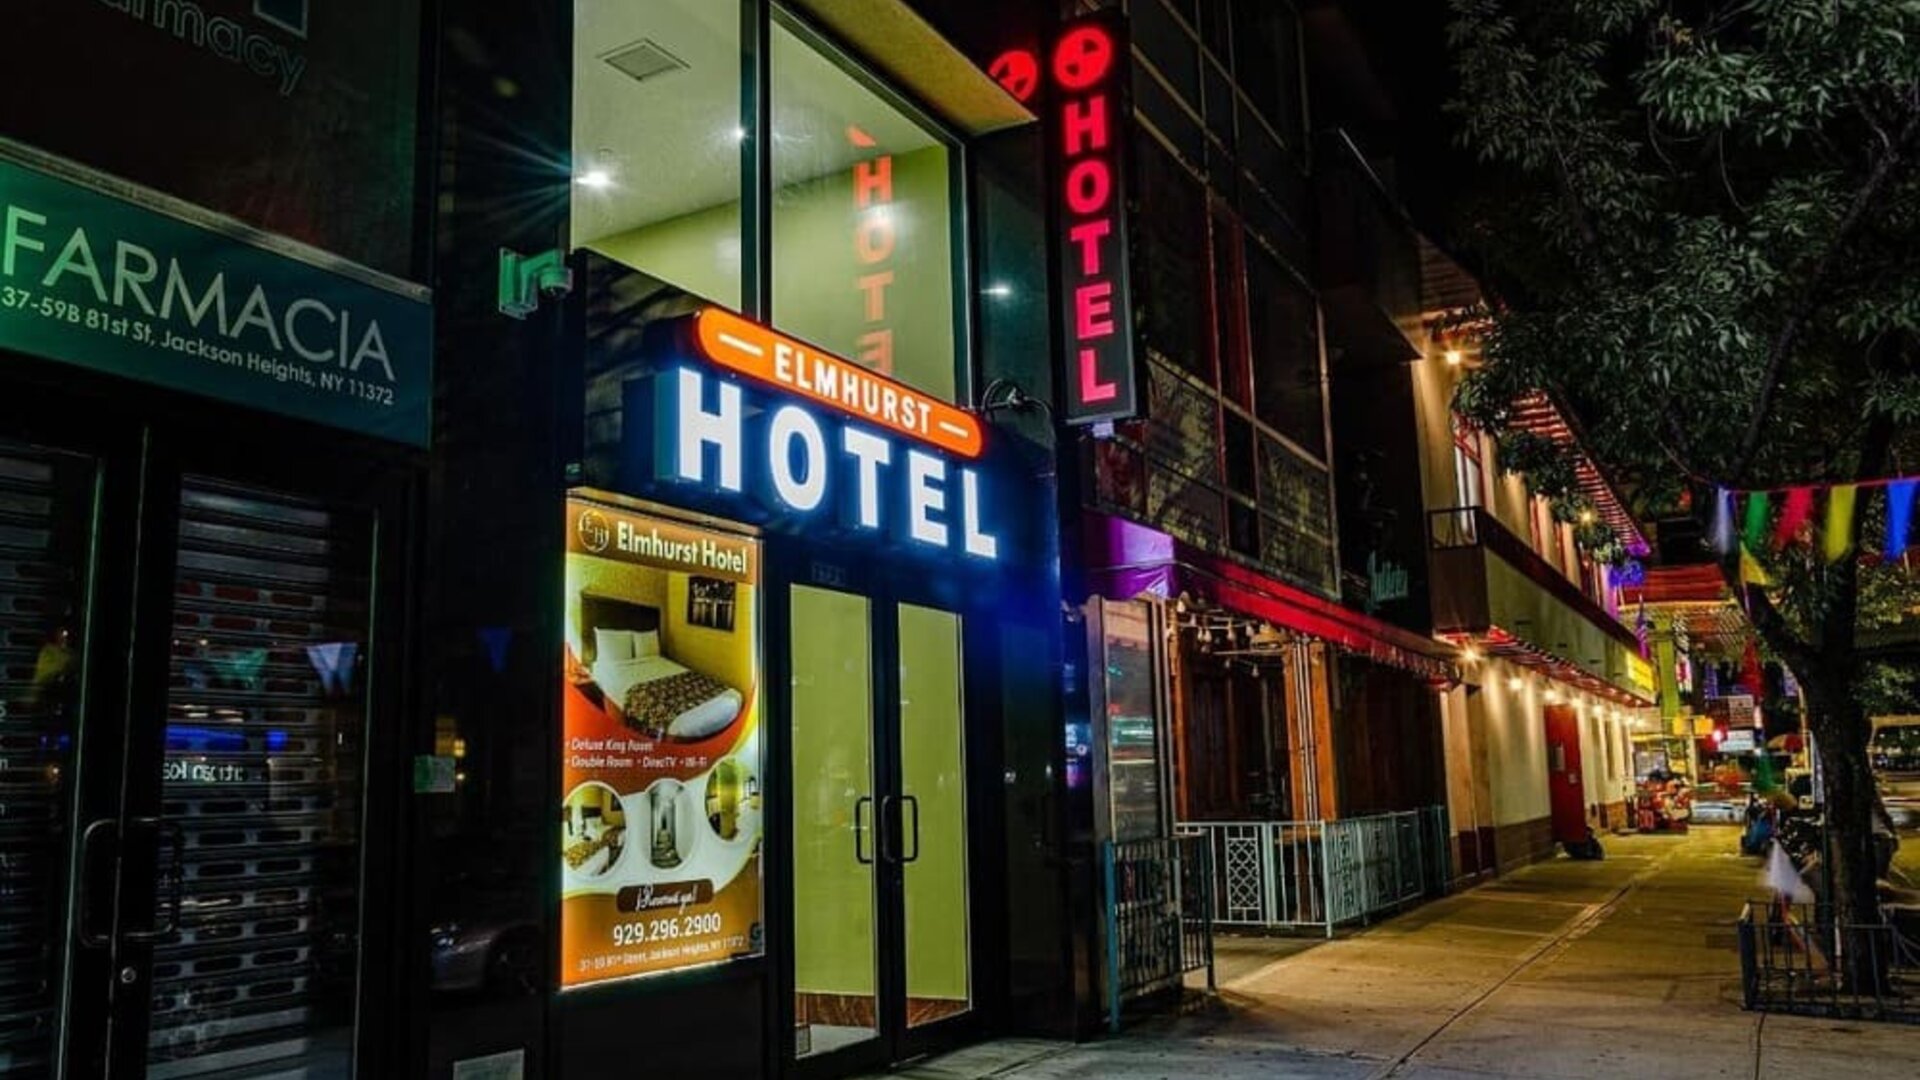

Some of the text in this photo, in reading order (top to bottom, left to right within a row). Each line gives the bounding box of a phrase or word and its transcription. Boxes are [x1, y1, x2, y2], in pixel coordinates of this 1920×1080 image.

[2, 205, 395, 381] FARMACIA
[1064, 96, 1116, 402] HOTEL
[1, 286, 394, 405] 37-59B 81st St, Jackson Heights, NY 11372
[774, 343, 932, 434] ELMHURST
[679, 366, 996, 559] HOTEL
[617, 520, 747, 573] Elmhurst Hotel
[613, 912, 721, 946] 929.296.2900
